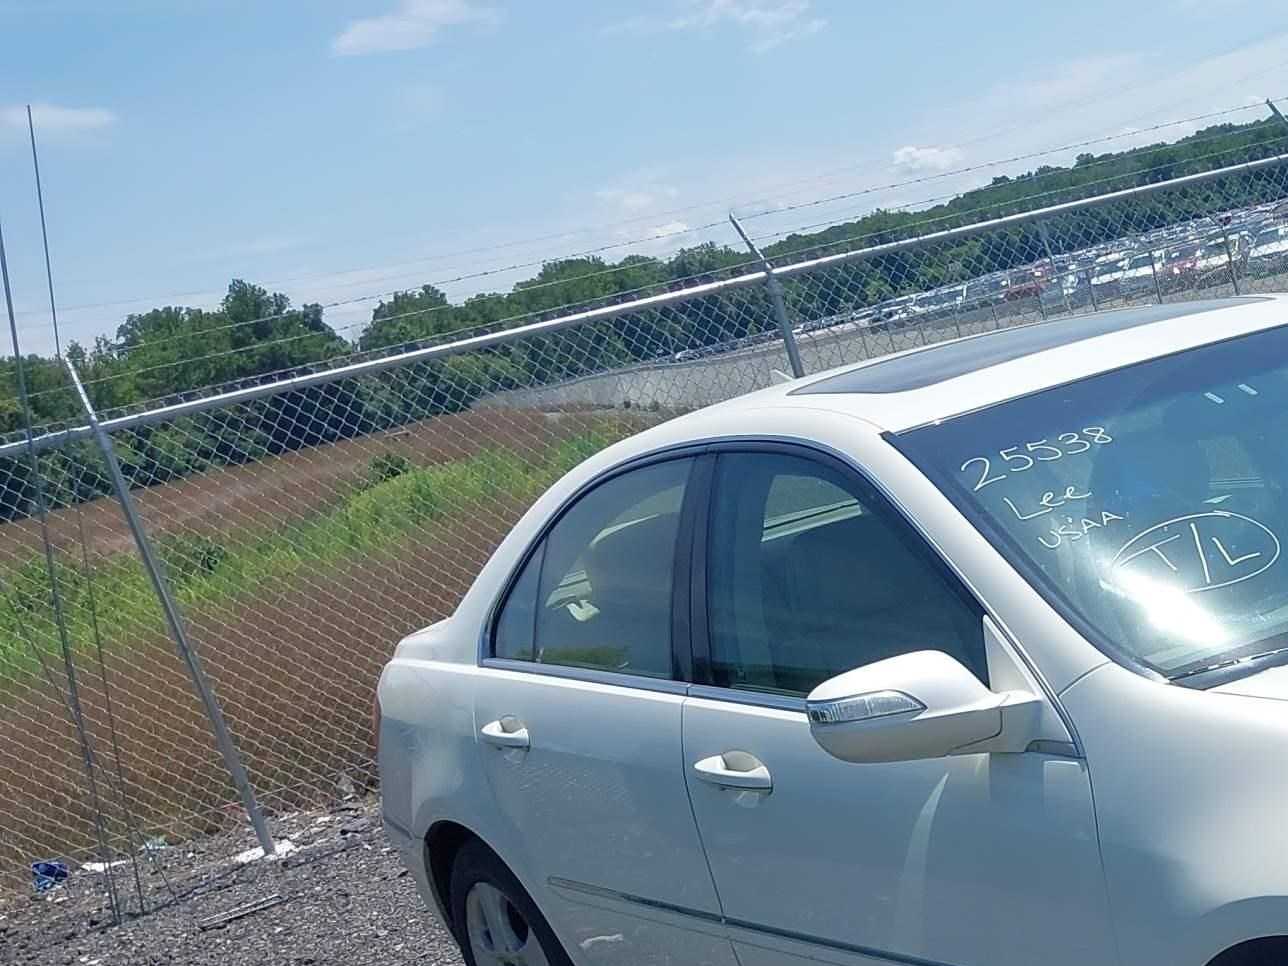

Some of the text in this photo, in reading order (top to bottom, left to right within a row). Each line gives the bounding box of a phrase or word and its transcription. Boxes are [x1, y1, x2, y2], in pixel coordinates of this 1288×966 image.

[960, 426, 1114, 492] 25538
[1003, 485, 1093, 521] Lee
[1037, 511, 1125, 550] USAA
[1116, 522, 1262, 584] T/L
